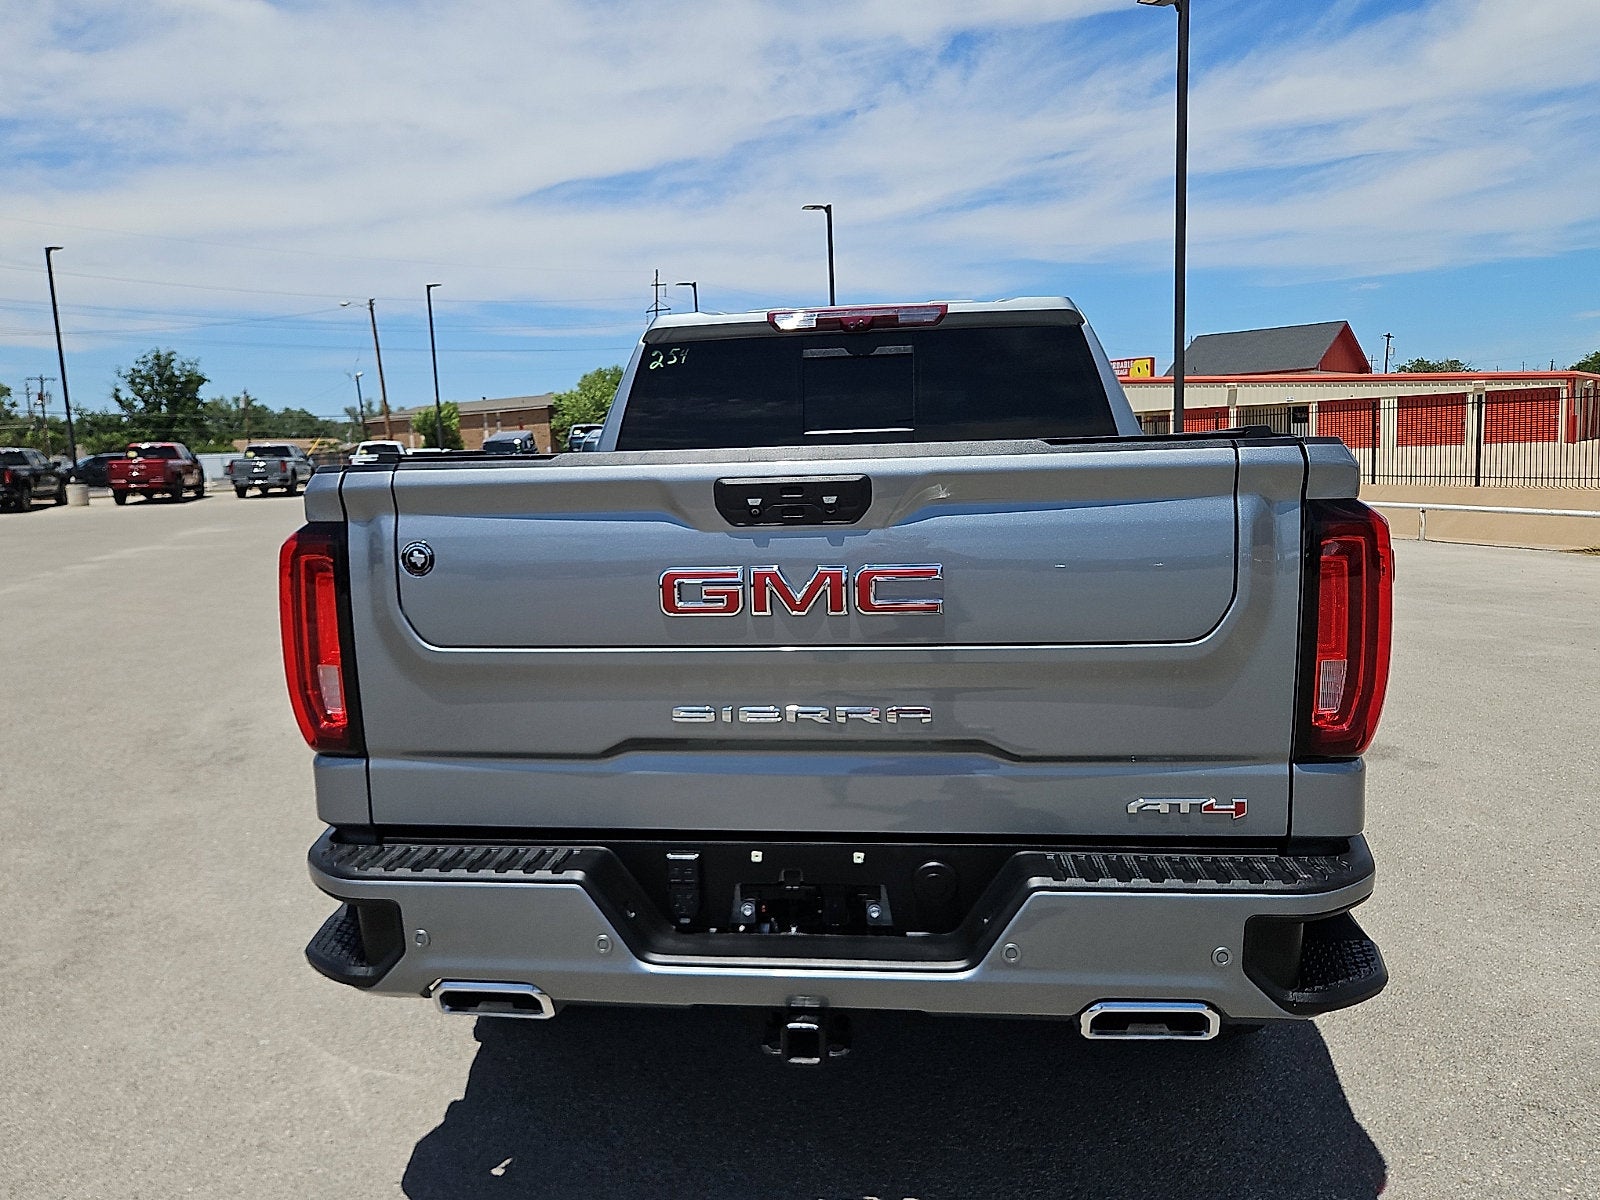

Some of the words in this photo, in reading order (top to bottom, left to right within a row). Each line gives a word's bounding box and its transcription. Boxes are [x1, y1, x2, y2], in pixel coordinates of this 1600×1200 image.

[658, 563, 944, 617] GMC
[671, 704, 932, 724] SIERRA
[1126, 797, 1248, 820] AT4
